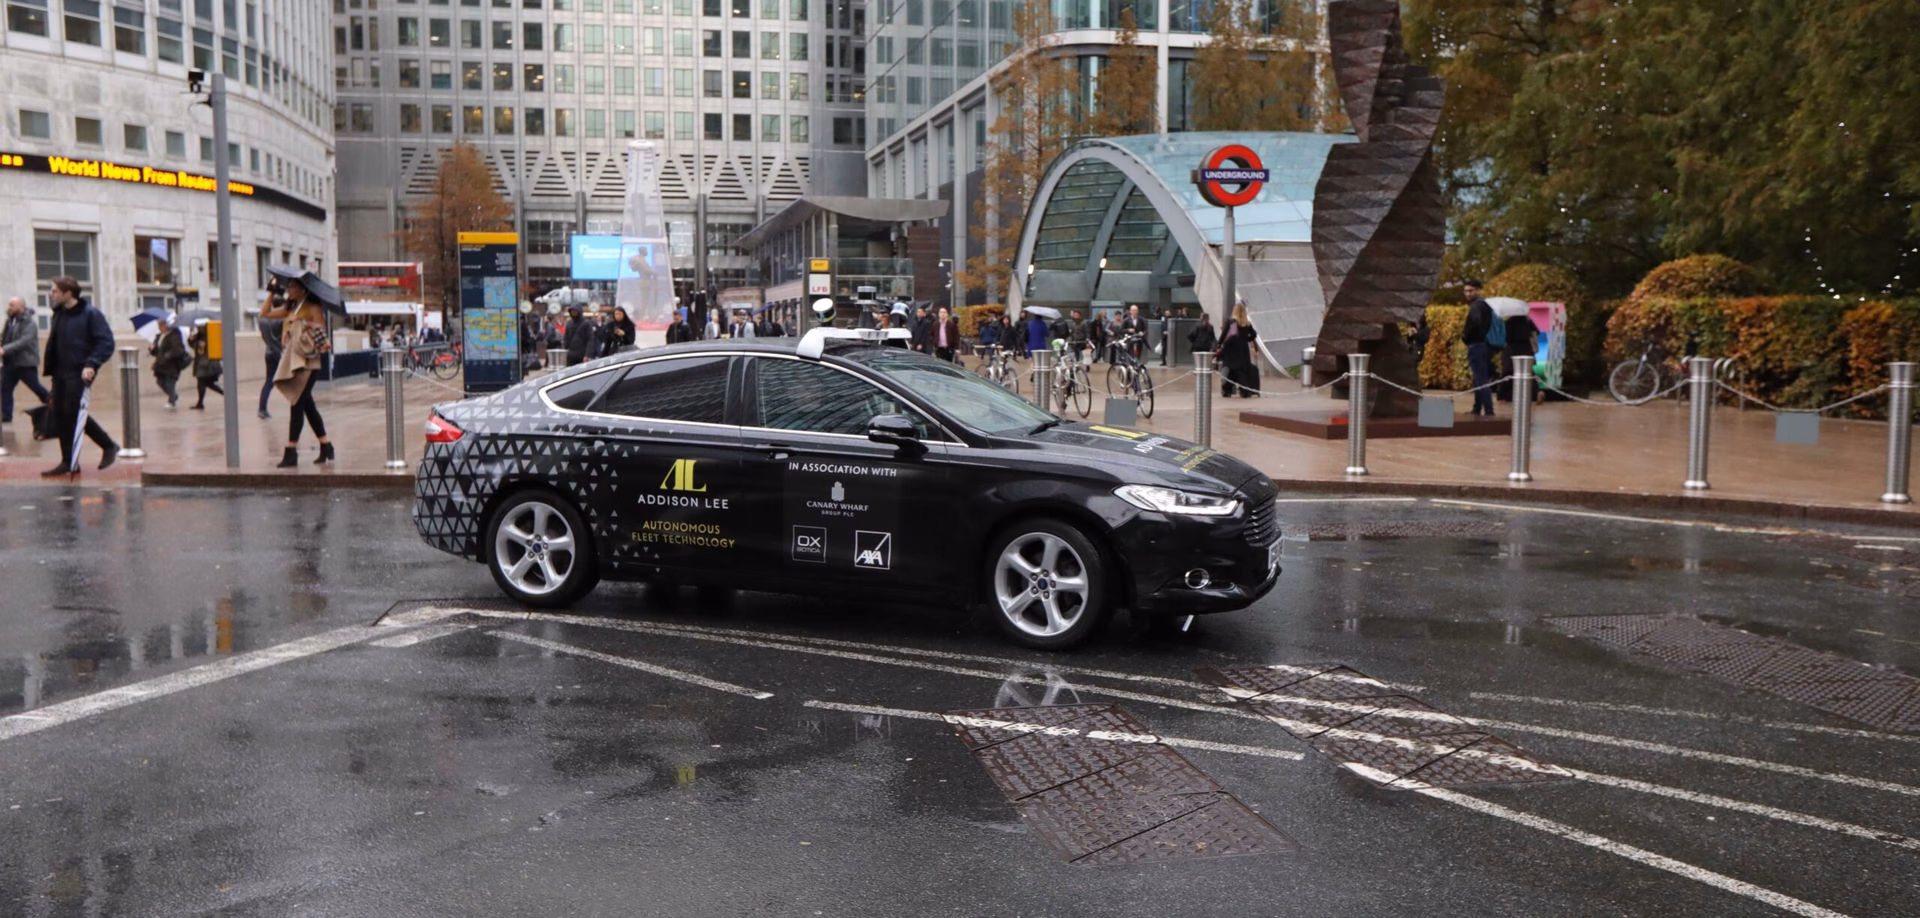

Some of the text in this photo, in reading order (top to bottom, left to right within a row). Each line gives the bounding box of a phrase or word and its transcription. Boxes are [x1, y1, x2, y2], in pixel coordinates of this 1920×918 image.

[48, 156, 99, 177] World
[101, 161, 140, 182] News
[143, 166, 177, 186] From
[1205, 171, 1265, 179] UNDERGROUND
[660, 458, 707, 492] AL
[788, 462, 897, 477] IN ASSOCIATION WITH
[637, 494, 729, 509] ADDISON LEE
[806, 501, 869, 511] CANARY WHARF
[643, 520, 721, 535] AUTONOMOUS
[631, 531, 735, 548] FLEET TECHNOLOGY
[797, 535, 821, 547] OX
[858, 549, 884, 566] AXA
